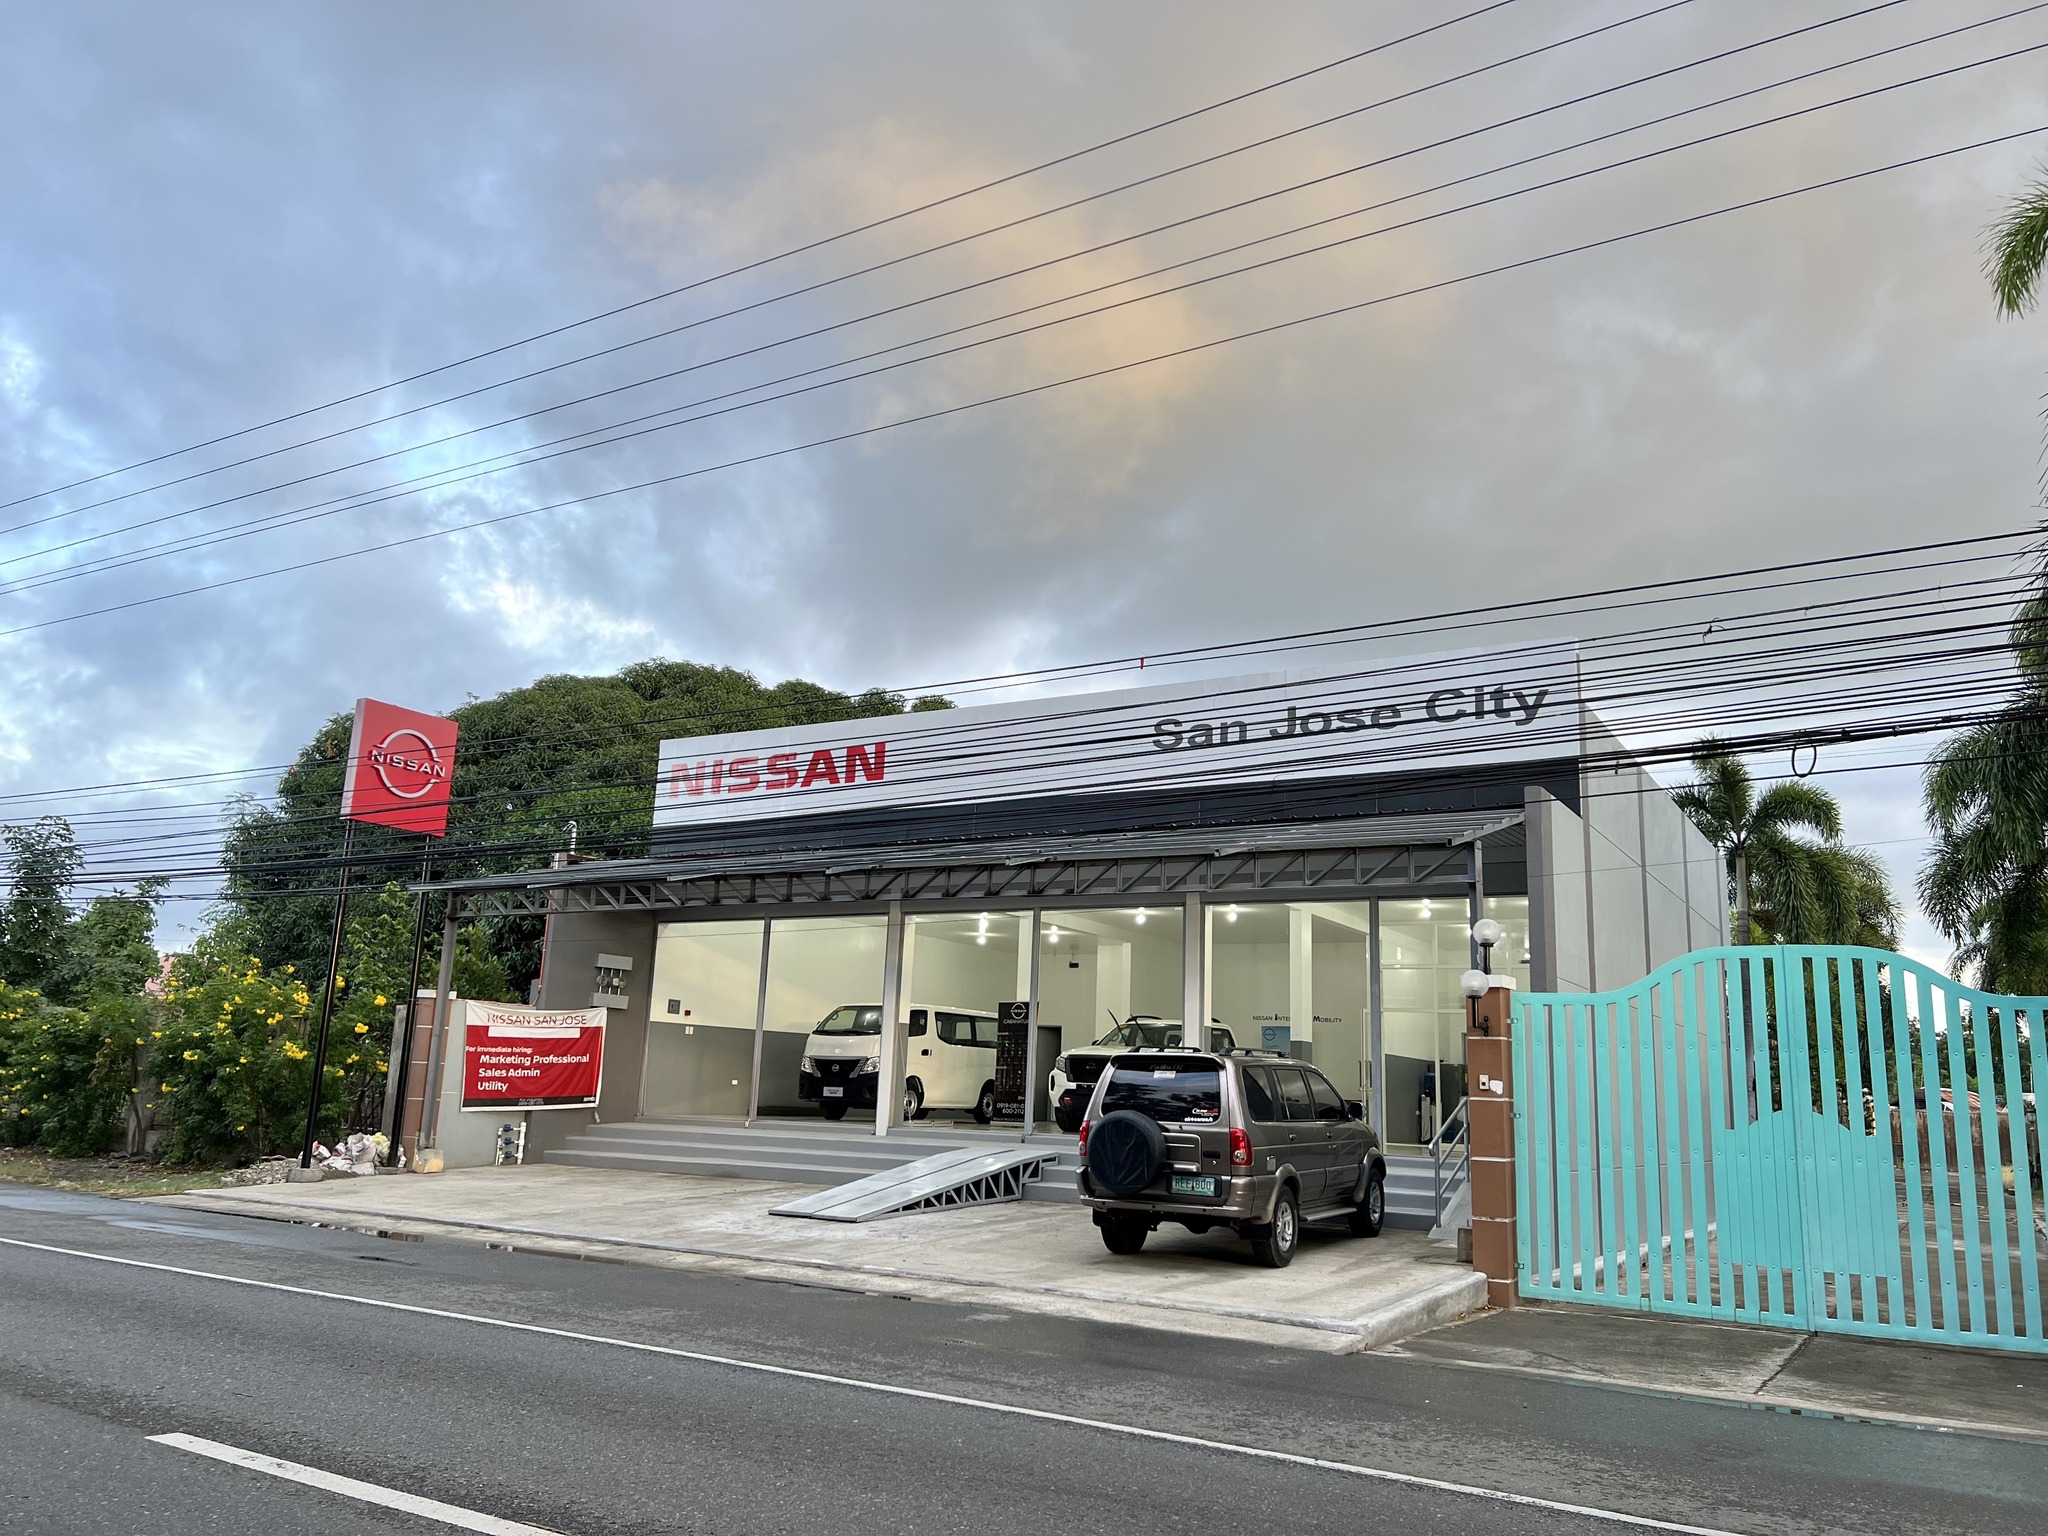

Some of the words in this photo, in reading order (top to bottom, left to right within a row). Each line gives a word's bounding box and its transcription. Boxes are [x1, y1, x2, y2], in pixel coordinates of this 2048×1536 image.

[1152, 717, 1248, 750] San
[1269, 705, 1402, 739] Jose
[1425, 684, 1549, 726] City
[371, 749, 446, 777] NISSAN
[669, 742, 886, 798] NISSAN
[487, 1013, 531, 1025] NISSAN
[533, 1015, 557, 1026] SAN
[558, 1015, 588, 1026] JOSE
[477, 1045, 512, 1053] immediate
[512, 1046, 533, 1054] hiring:
[479, 1055, 531, 1066] Marketing
[532, 1054, 590, 1064] Professional
[478, 1068, 507, 1077] Sales
[508, 1068, 540, 1077] Admin
[477, 1081, 509, 1092] Utility
[1175, 1177, 1191, 1189] REE
